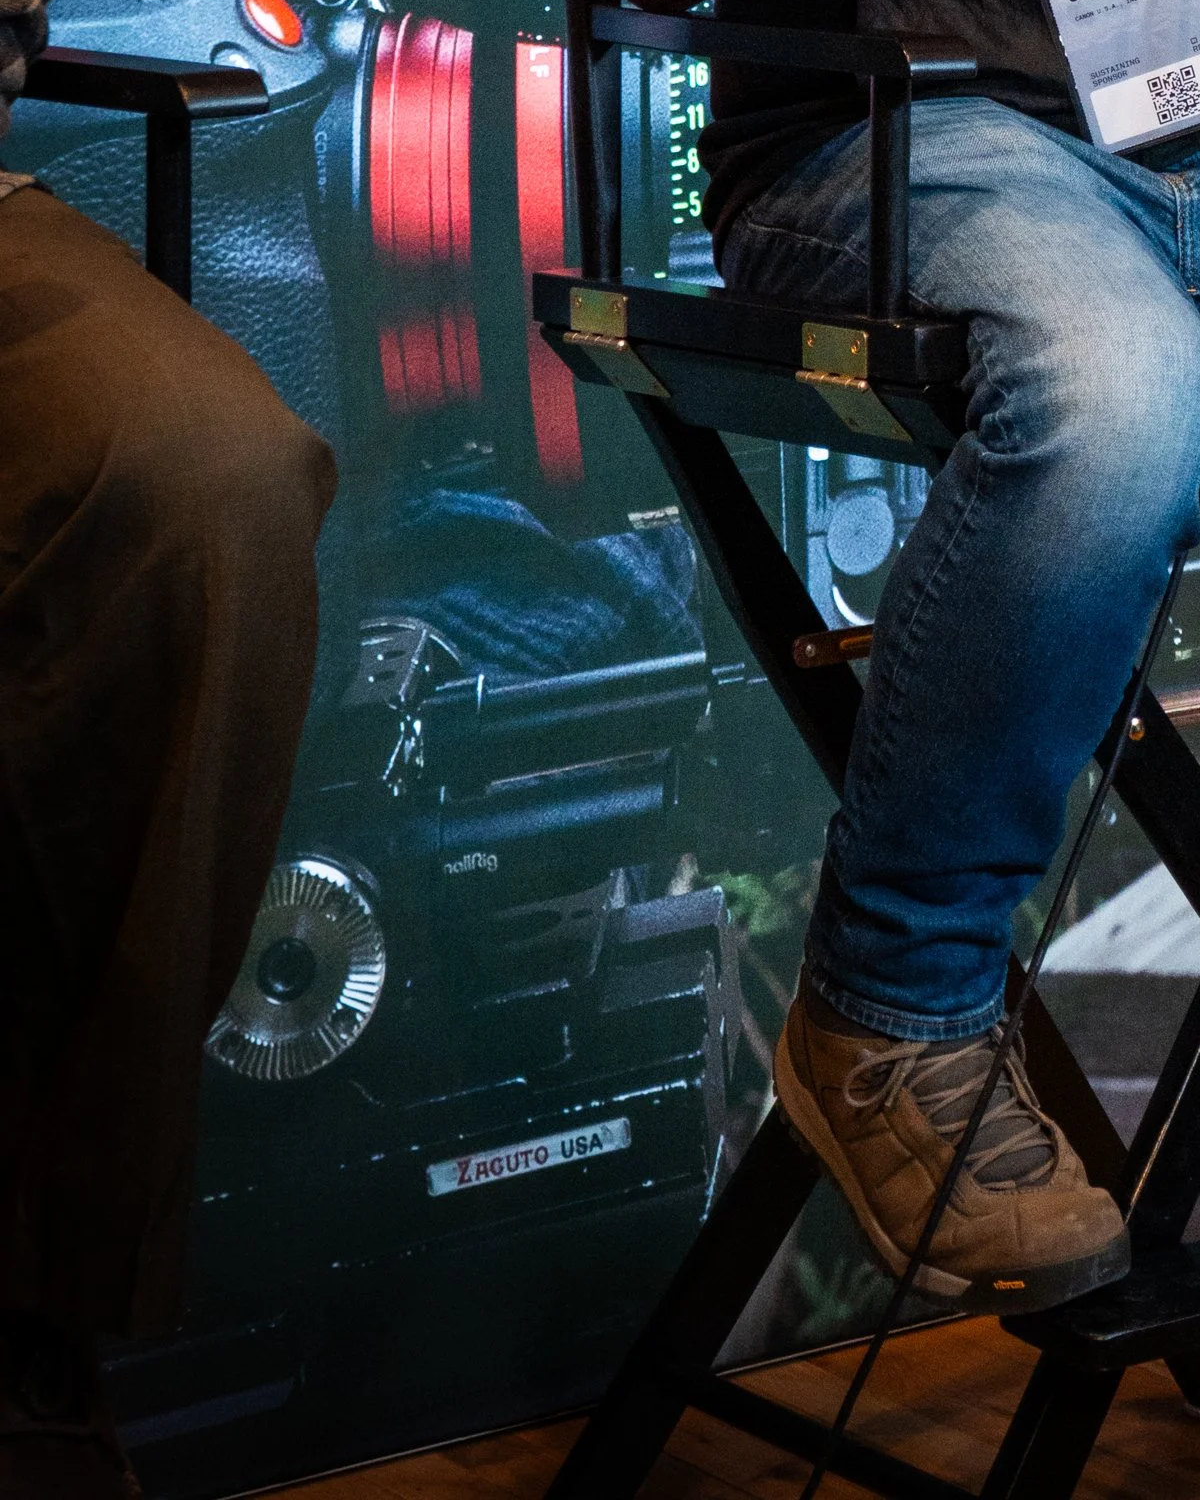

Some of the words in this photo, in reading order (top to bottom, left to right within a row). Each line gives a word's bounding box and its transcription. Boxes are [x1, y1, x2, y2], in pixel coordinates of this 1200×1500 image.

[687, 61, 710, 89] 16
[1090, 57, 1140, 80] SUSTAINING
[1092, 70, 1128, 88] SPONSOR
[686, 102, 706, 131] 11
[687, 146, 700, 175] 8
[443, 852, 498, 874] allRig
[560, 1132, 604, 1160] USA
